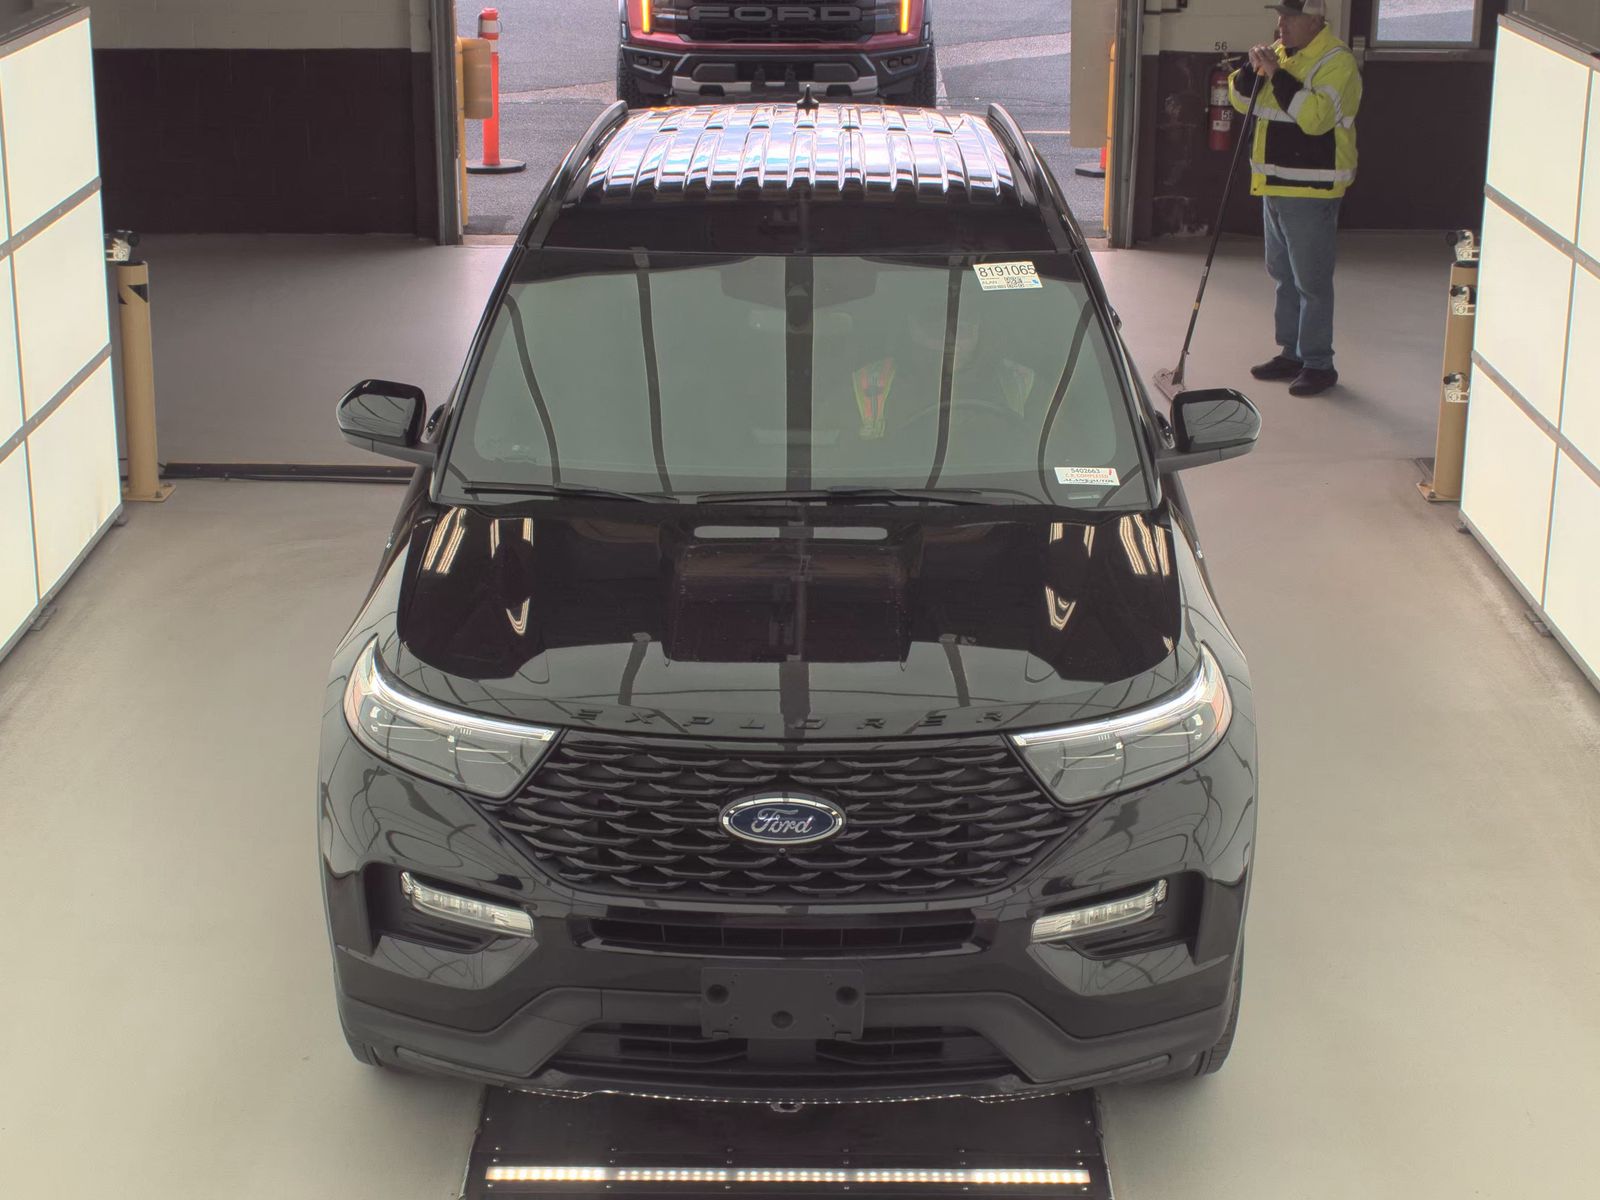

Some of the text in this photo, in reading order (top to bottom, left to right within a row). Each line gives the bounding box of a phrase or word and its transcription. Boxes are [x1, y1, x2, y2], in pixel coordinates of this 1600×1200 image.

[688, 6, 863, 21] FORD
[1214, 41, 1228, 51] 56
[978, 264, 1037, 278] 8191065
[569, 708, 1003, 732] EXPLORER
[750, 807, 815, 835] Ford
